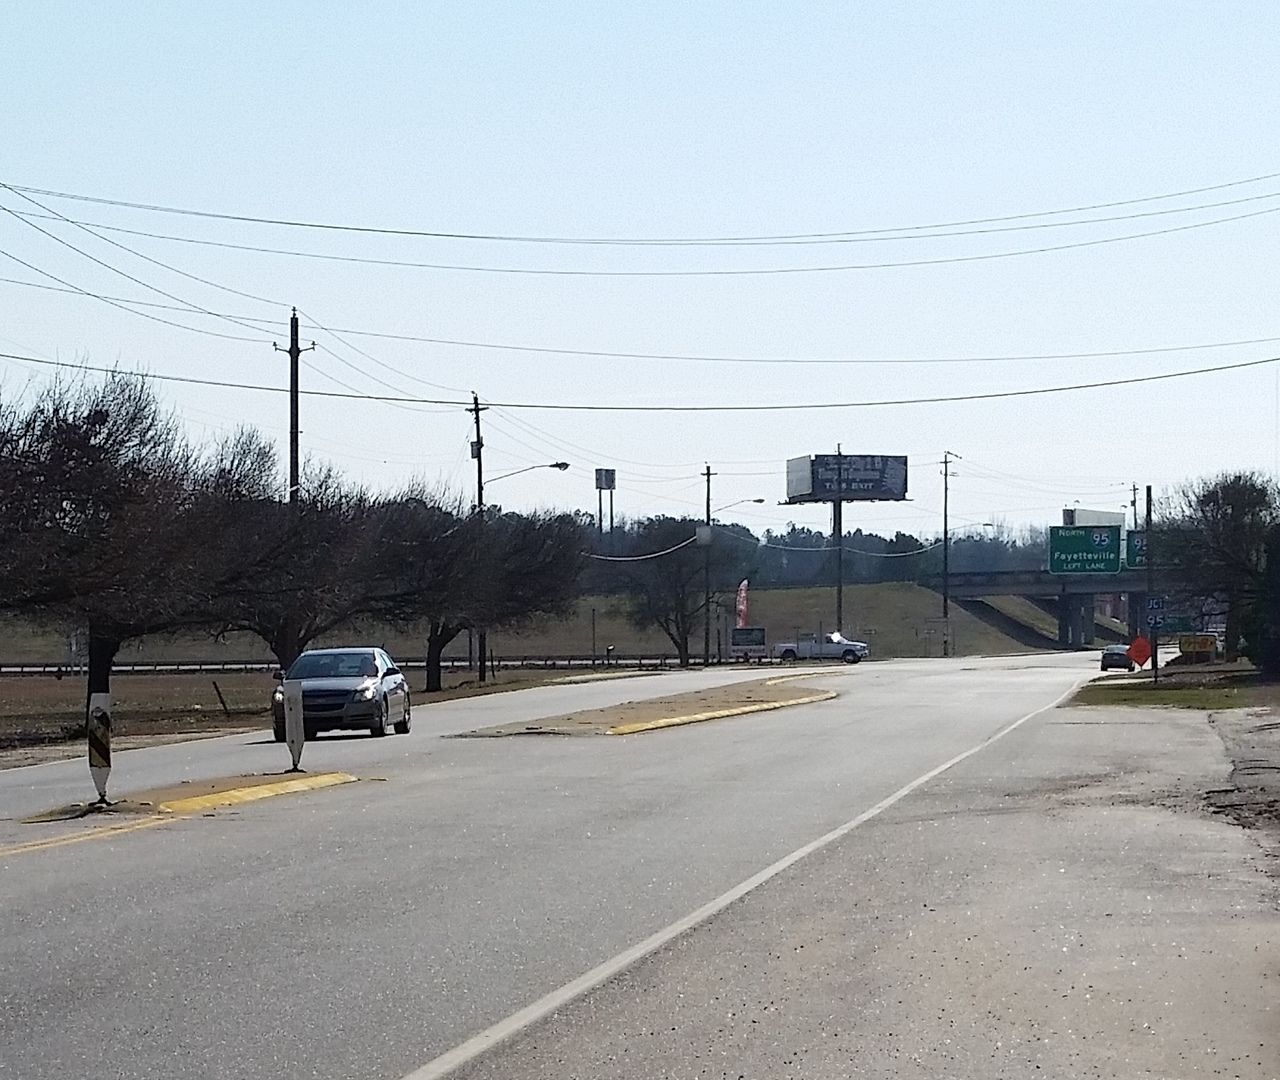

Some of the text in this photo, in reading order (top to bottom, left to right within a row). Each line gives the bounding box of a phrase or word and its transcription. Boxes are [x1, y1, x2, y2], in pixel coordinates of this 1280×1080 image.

[1059, 529, 1109, 546] NORTH 95
[1054, 551, 1115, 562] Fayetteville
[1147, 599, 1164, 609] JCT
[1147, 615, 1164, 627] 95
